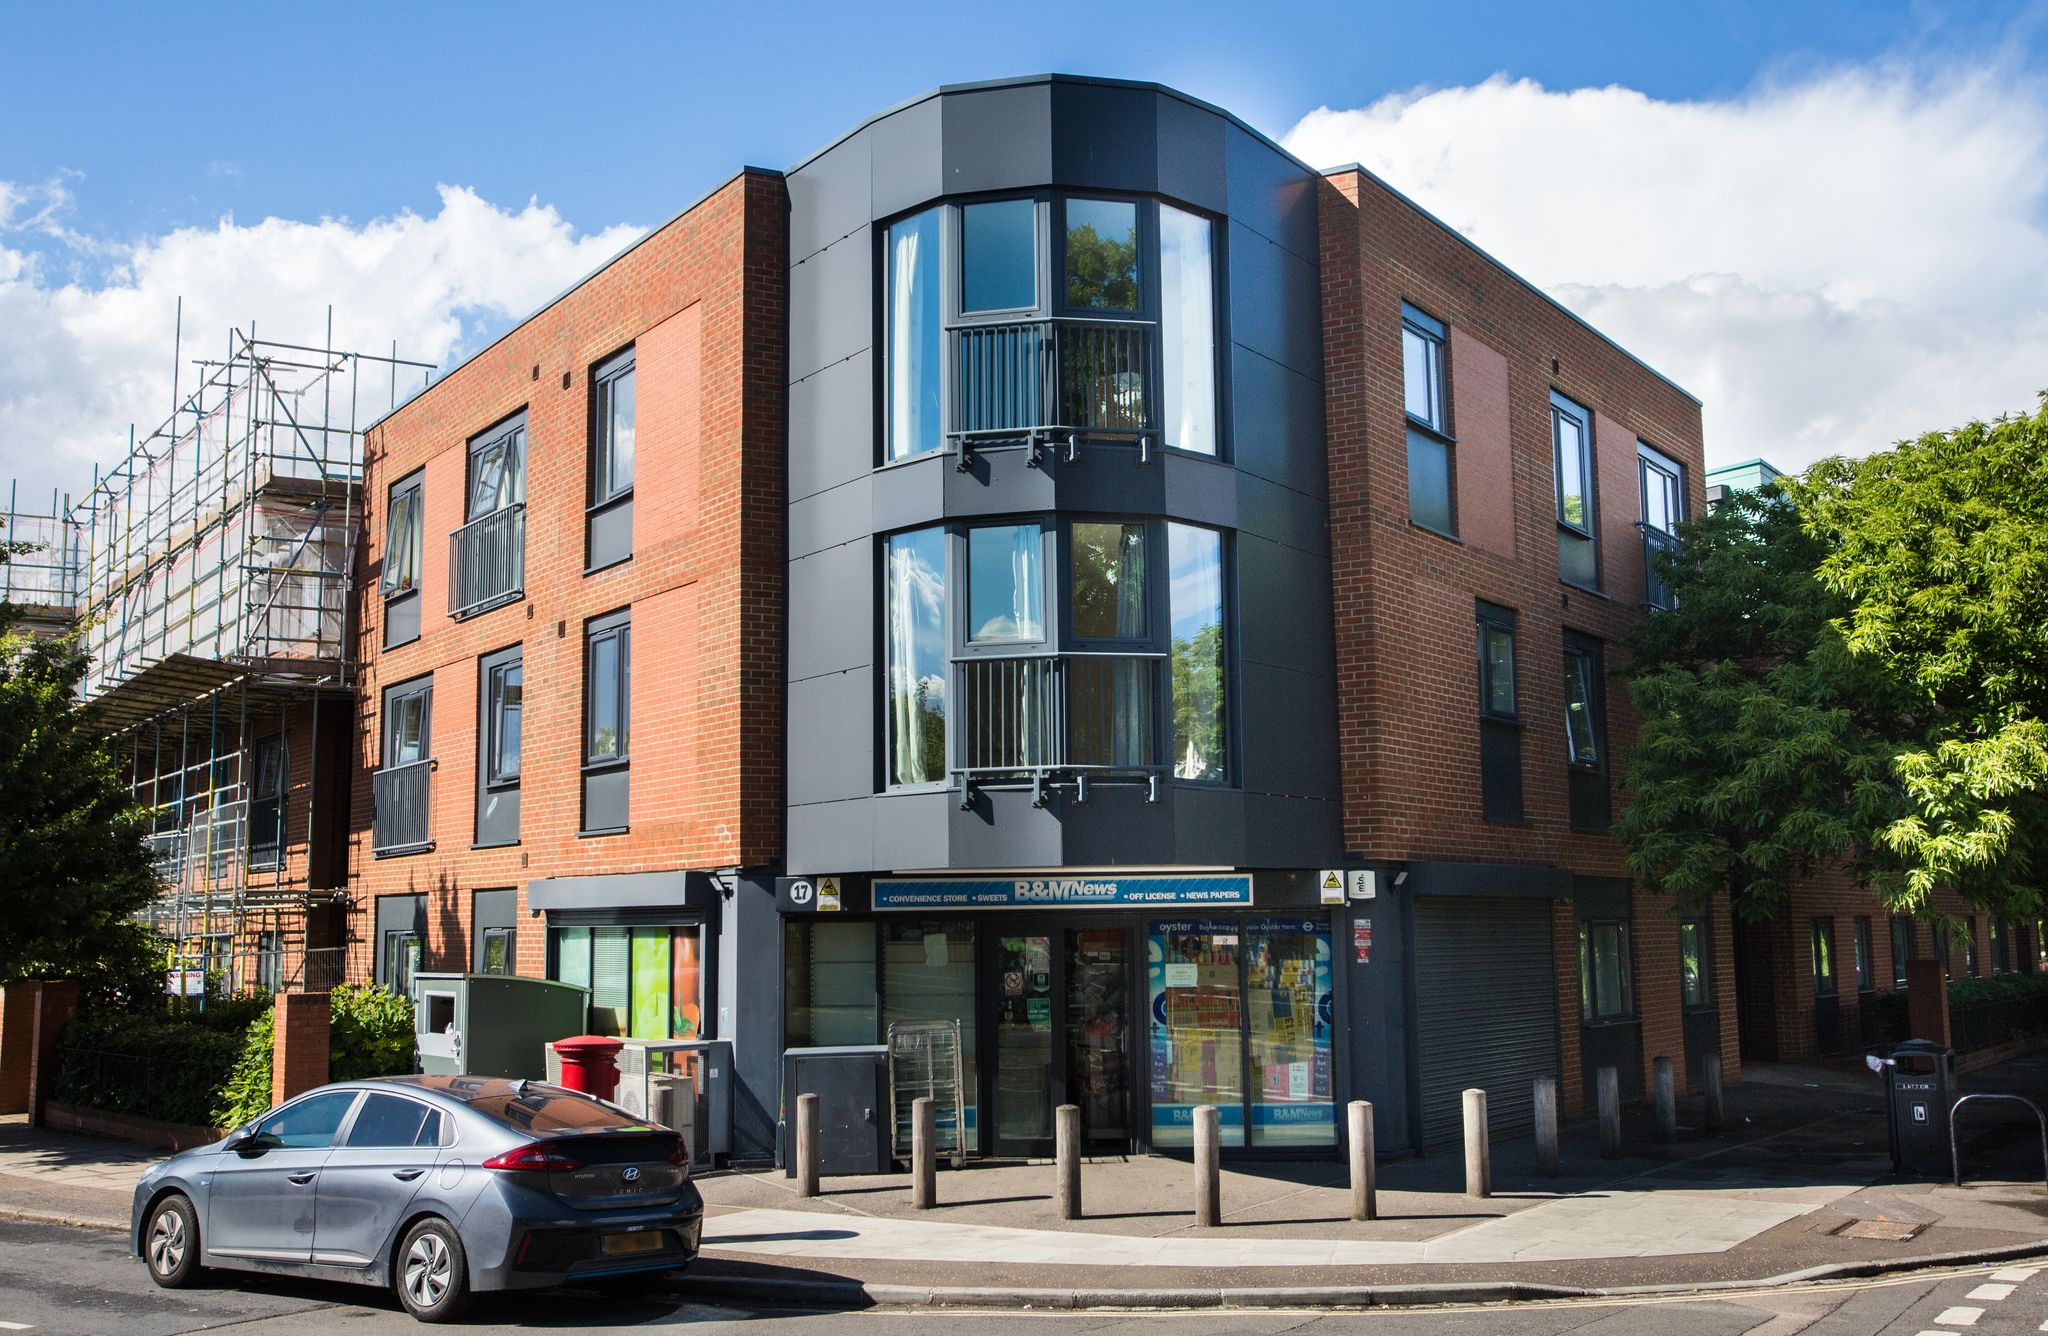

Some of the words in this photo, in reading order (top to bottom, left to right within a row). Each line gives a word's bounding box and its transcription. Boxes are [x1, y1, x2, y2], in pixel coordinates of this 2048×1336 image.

[794, 884, 809, 900] 17
[1129, 893, 1145, 901] OFF
[1145, 892, 1176, 900] LICENSE
[1186, 891, 1209, 899] NEWS
[1210, 891, 1241, 899] PAPERS
[888, 894, 942, 903] CONVENIENCE
[943, 894, 968, 902] STORE
[977, 894, 1008, 902] SWEETS
[1159, 922, 1192, 933] oyster
